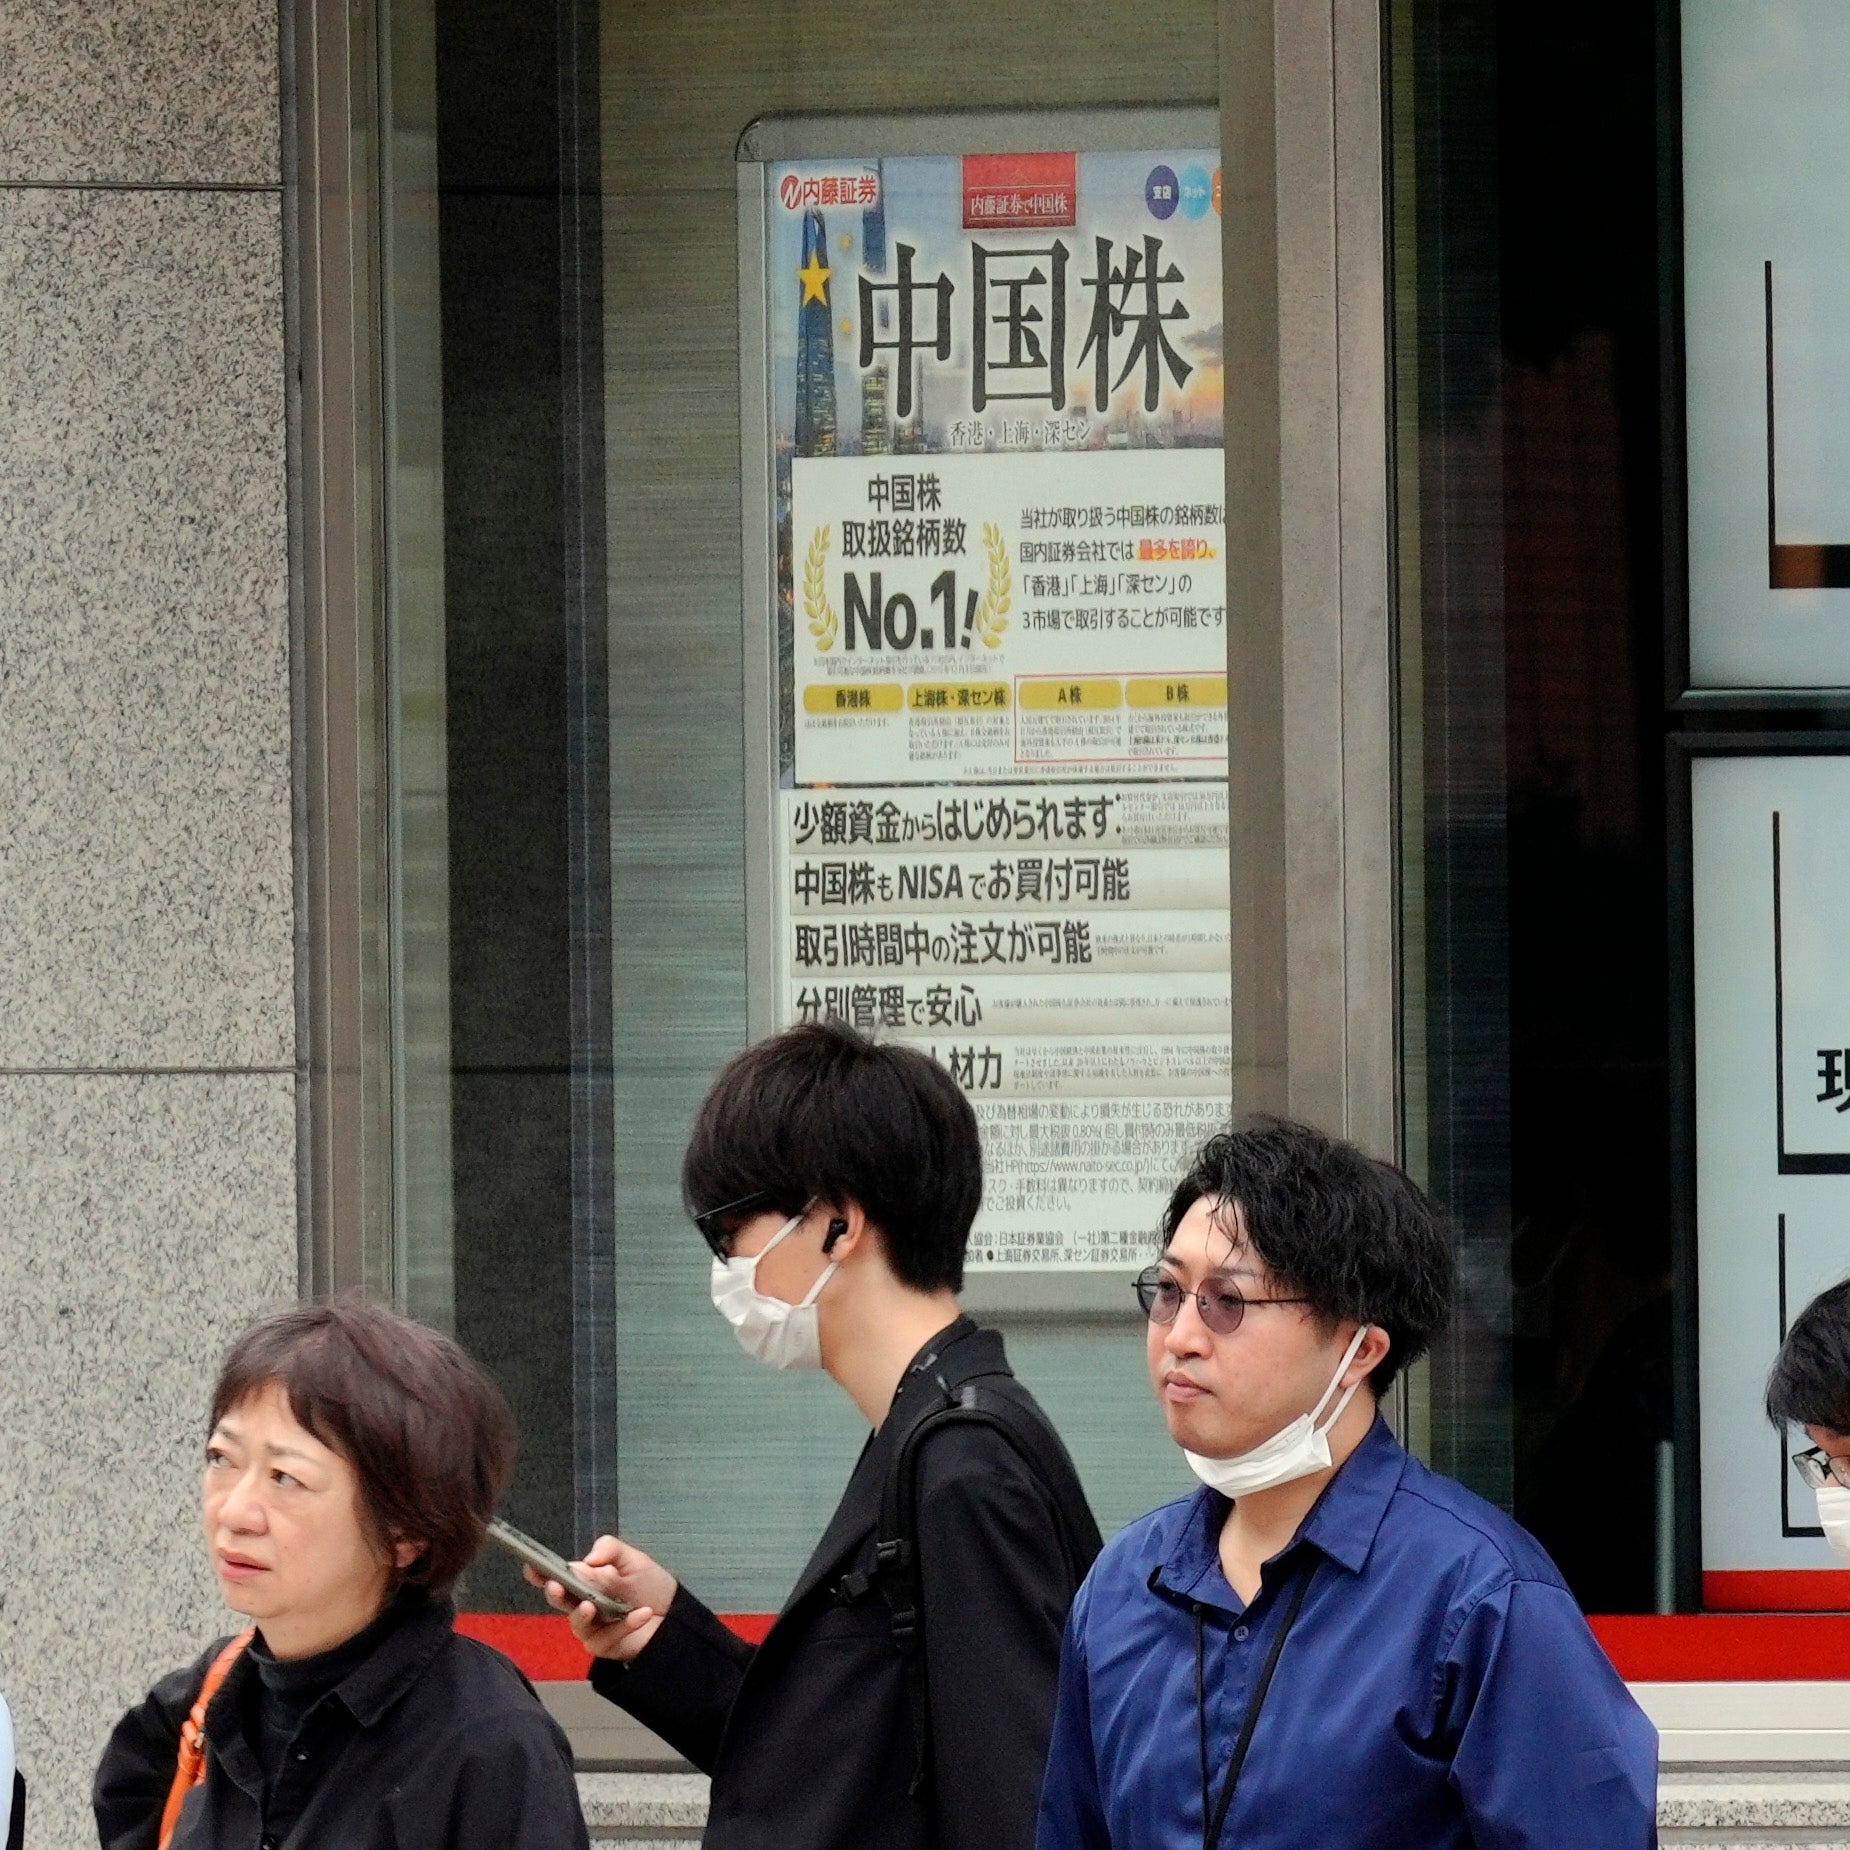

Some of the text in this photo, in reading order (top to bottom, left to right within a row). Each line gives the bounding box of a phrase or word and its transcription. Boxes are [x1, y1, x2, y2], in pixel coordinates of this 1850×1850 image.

[803, 175, 876, 206] 内藤証券
[858, 234, 1193, 419] 中国株
[950, 419, 1092, 447] 香港・上海・深セン
[868, 473, 942, 512] 中国株
[842, 517, 967, 558] 取扱銘柄数
[843, 569, 979, 651] No.1!
[794, 795, 1114, 845] 少額資金からはじめられます
[795, 919, 1092, 968] 取引時間中の注文が可能
[796, 982, 982, 1029] 分別管理で安心
[930, 1045, 1002, 1091] 材力
